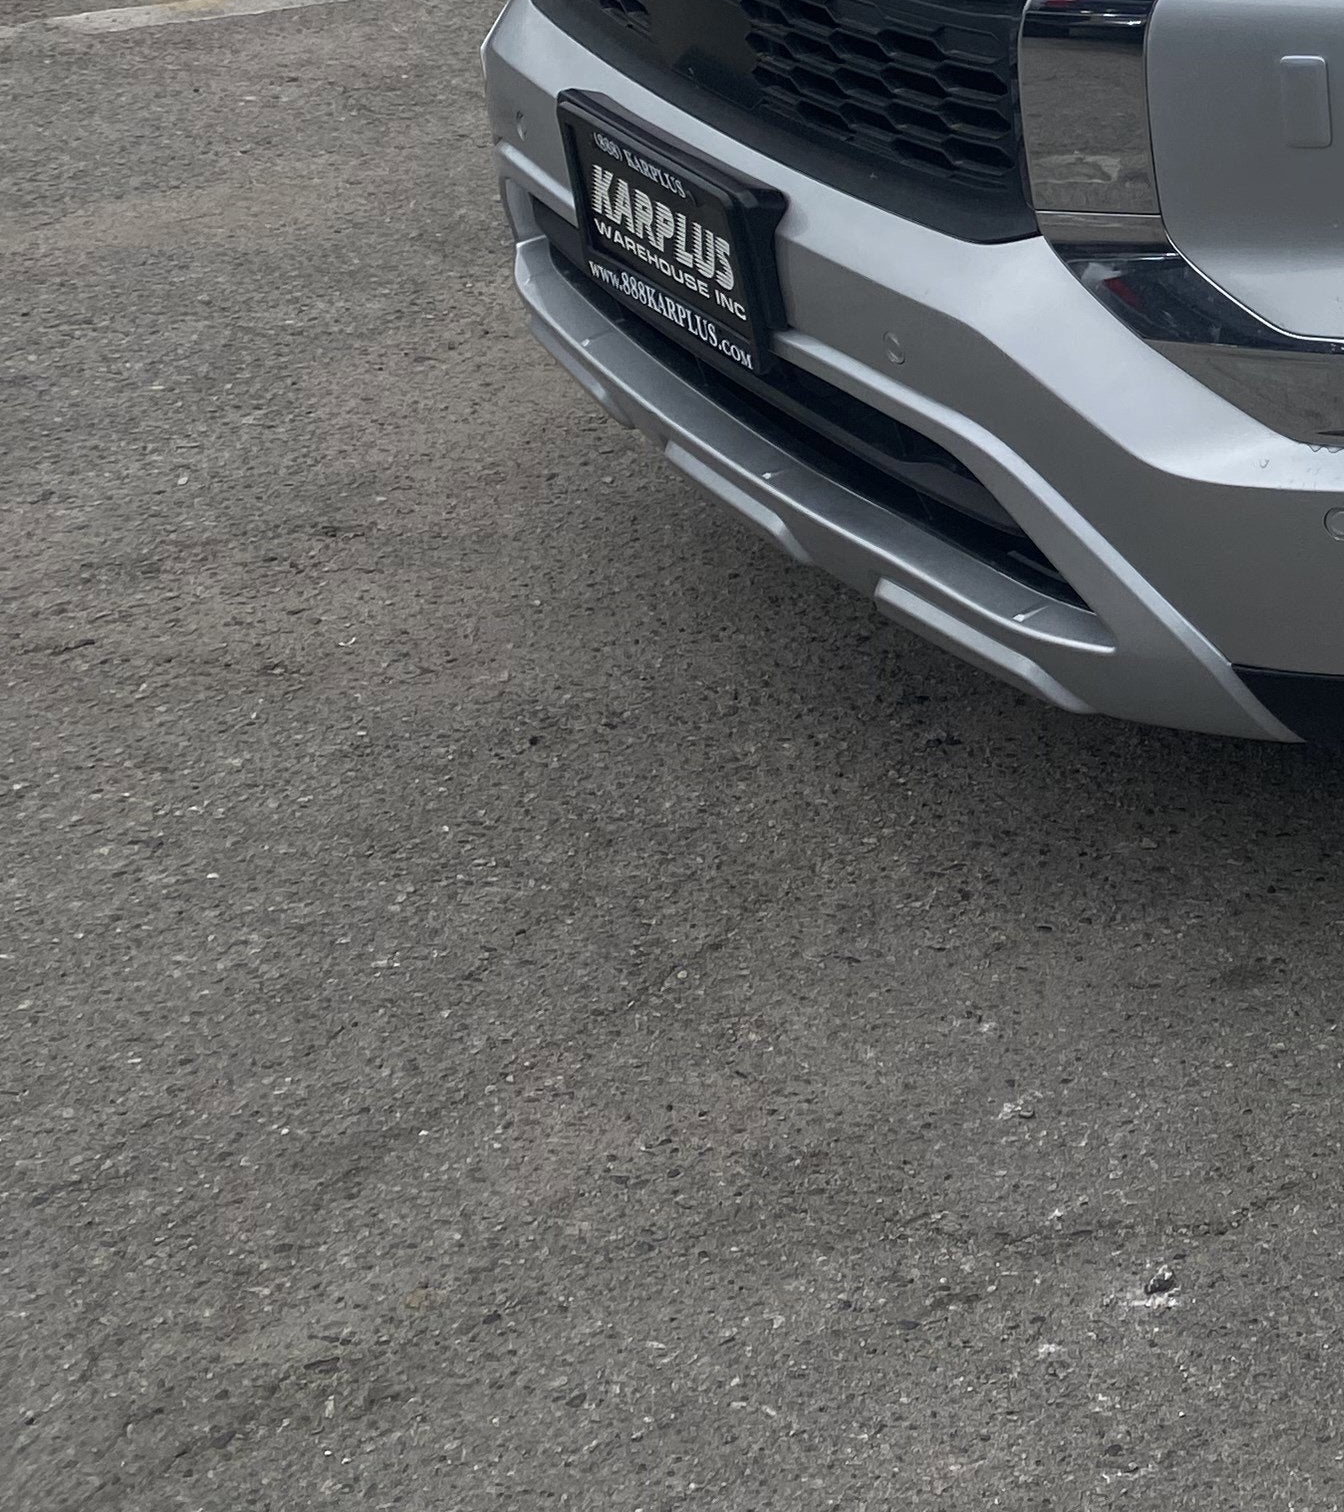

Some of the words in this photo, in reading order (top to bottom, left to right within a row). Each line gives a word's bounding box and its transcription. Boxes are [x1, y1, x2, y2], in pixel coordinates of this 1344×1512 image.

[623, 149, 686, 198] KARPLUS
[592, 164, 735, 290] KARPLUS
[594, 218, 710, 299] WAREHOUSE
[715, 289, 747, 321] INC
